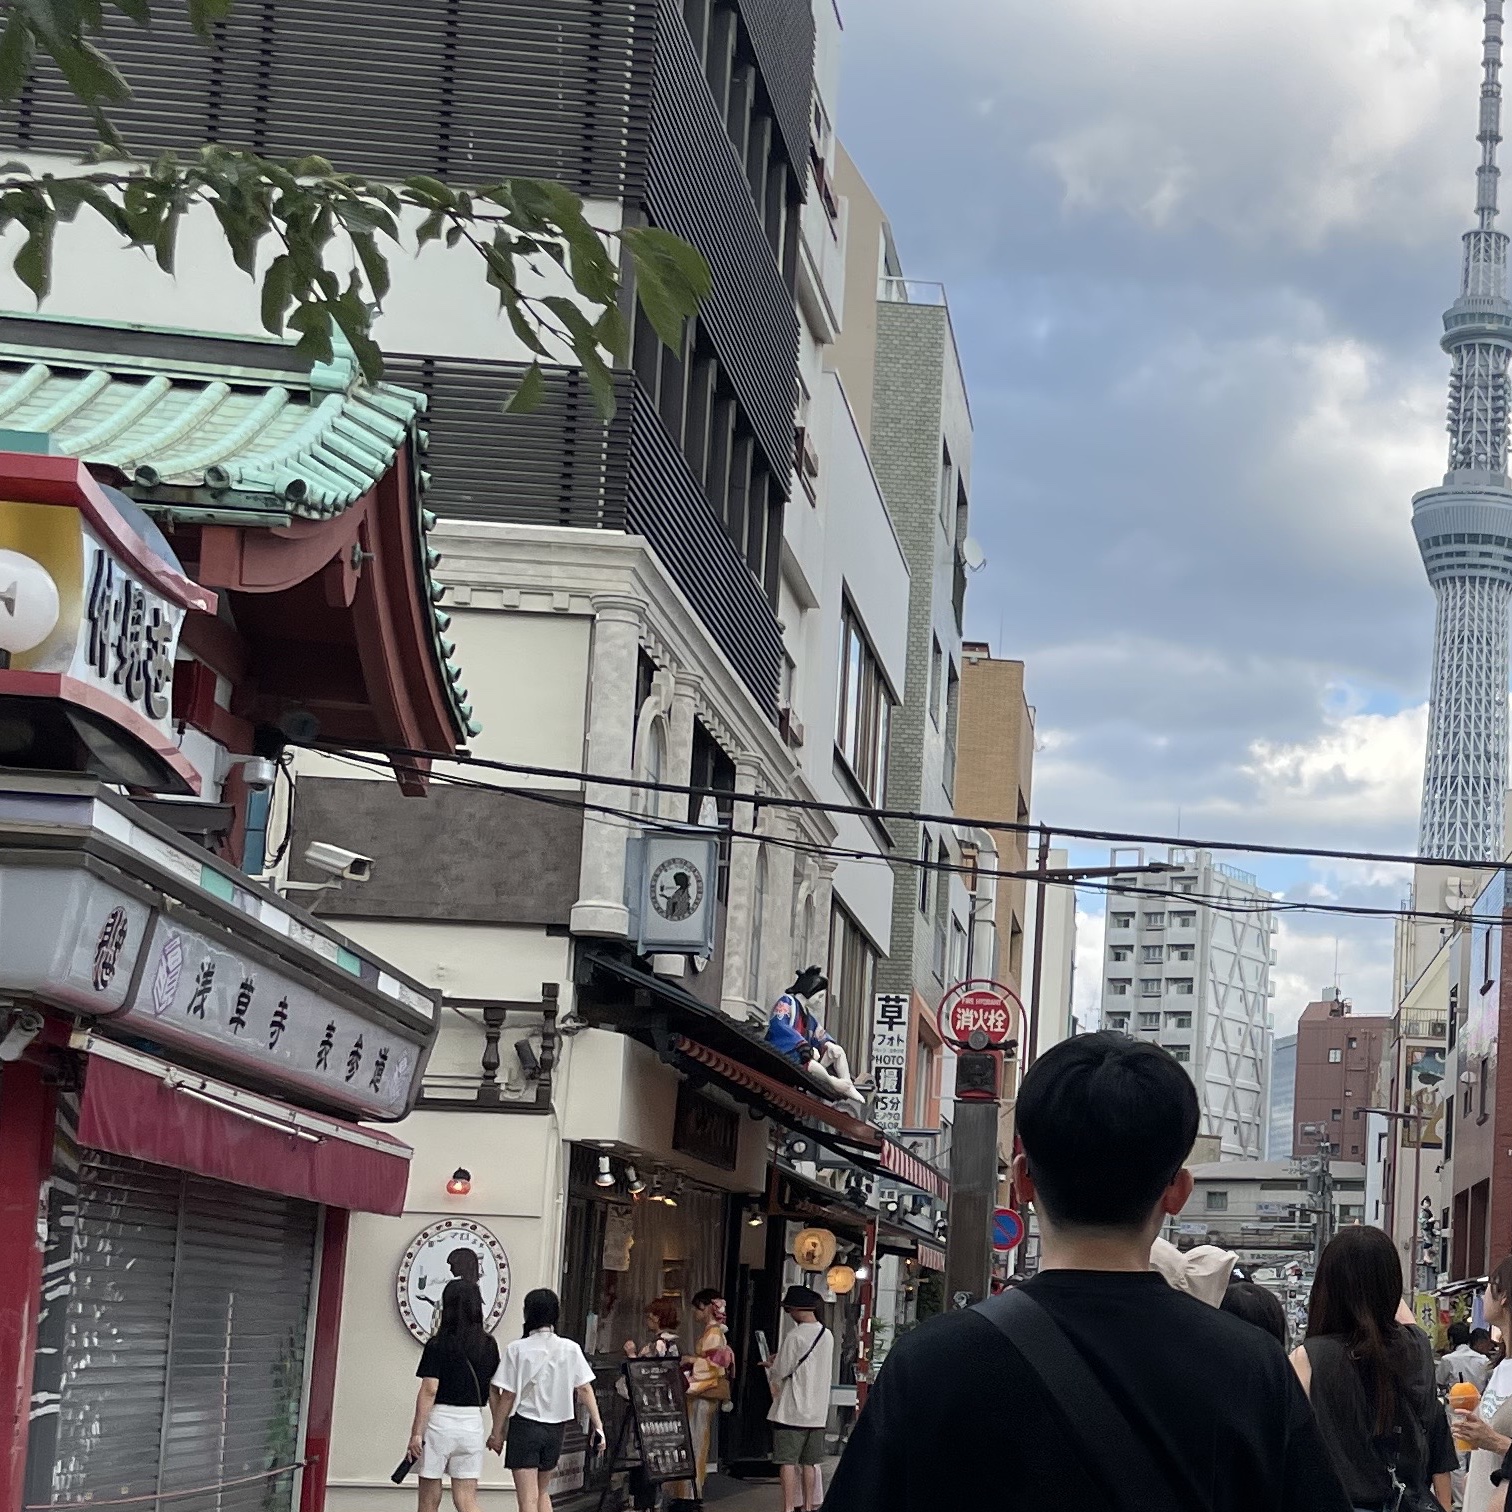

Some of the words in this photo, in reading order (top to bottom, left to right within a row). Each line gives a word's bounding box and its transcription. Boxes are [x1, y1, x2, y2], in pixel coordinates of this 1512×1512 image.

[876, 995, 908, 1031] 草
[956, 1008, 1007, 1032] 消火栓
[877, 1033, 905, 1047] フォト
[875, 1097, 901, 1111] 15分
